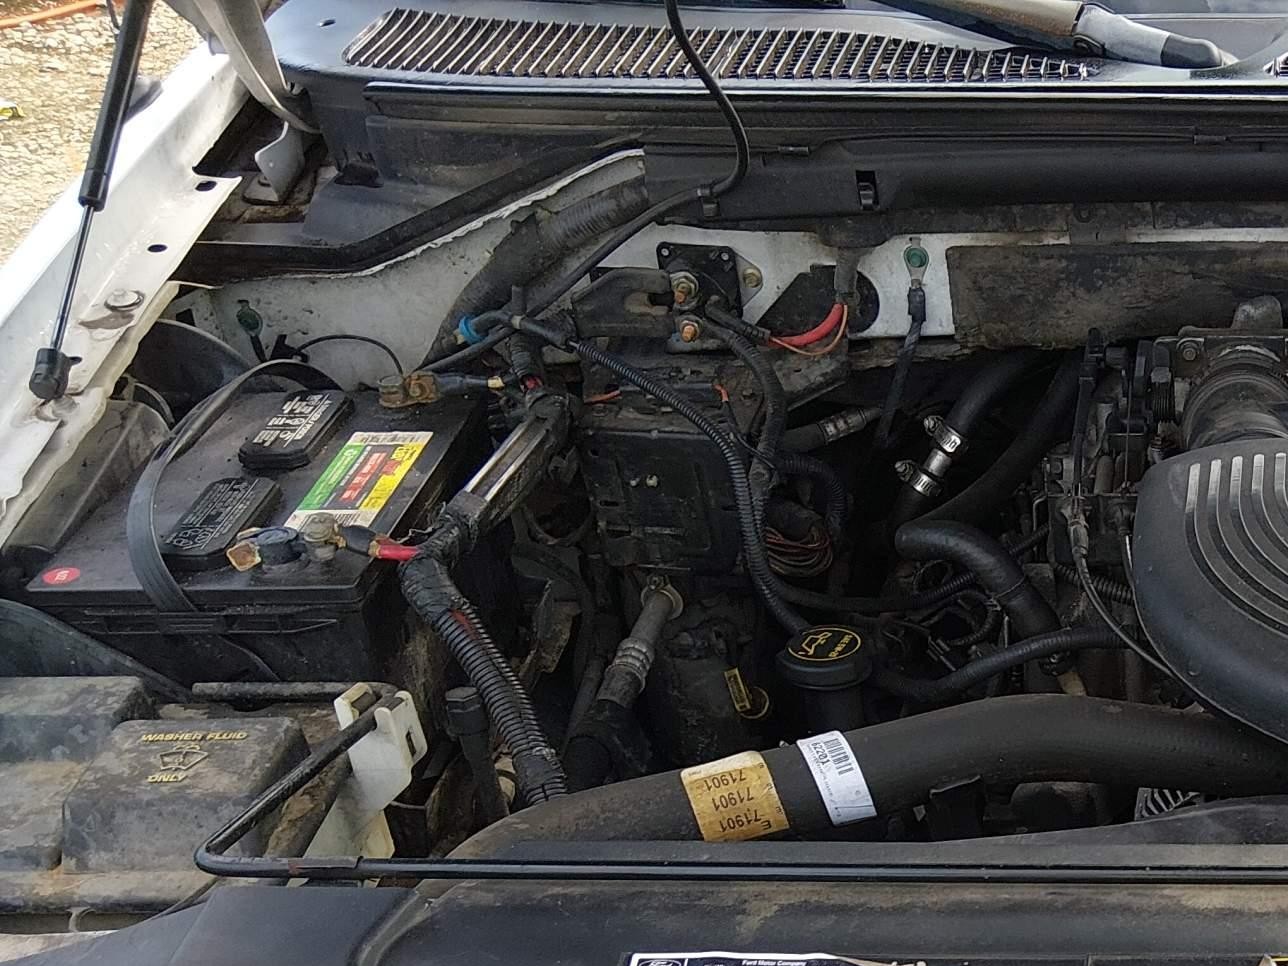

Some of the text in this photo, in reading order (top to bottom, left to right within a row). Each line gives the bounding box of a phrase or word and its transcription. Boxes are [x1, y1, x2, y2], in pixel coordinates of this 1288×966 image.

[142, 731, 248, 741] WASHER FLUID
[704, 769, 746, 791] 71901
[712, 787, 754, 811] 71901
[720, 809, 762, 832] 71901
